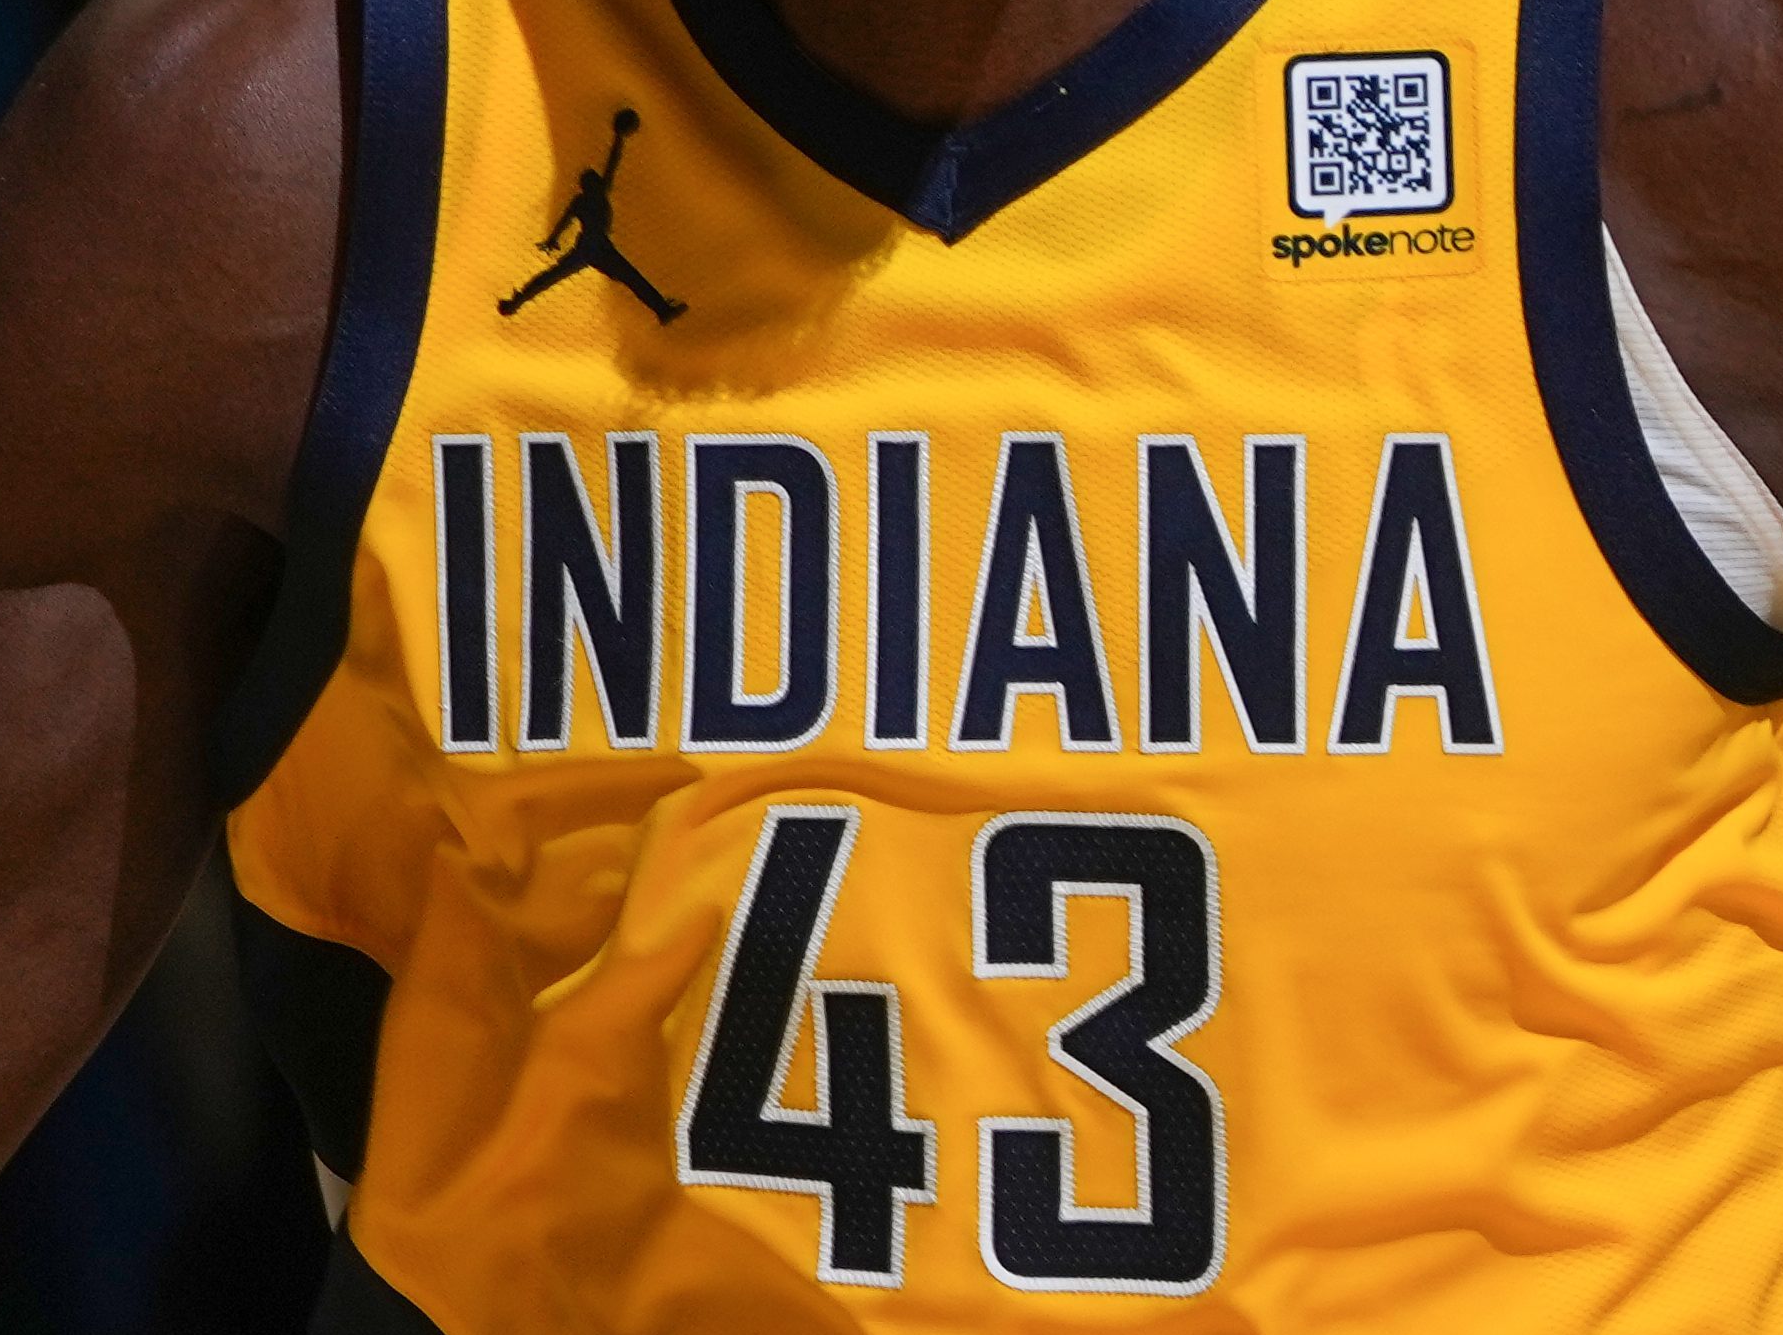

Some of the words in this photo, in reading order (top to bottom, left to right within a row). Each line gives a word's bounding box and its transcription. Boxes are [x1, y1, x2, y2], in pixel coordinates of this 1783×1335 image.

[1270, 222, 1476, 268] spokenote
[433, 430, 1504, 757] INDIANA
[674, 803, 1230, 1298] 43
